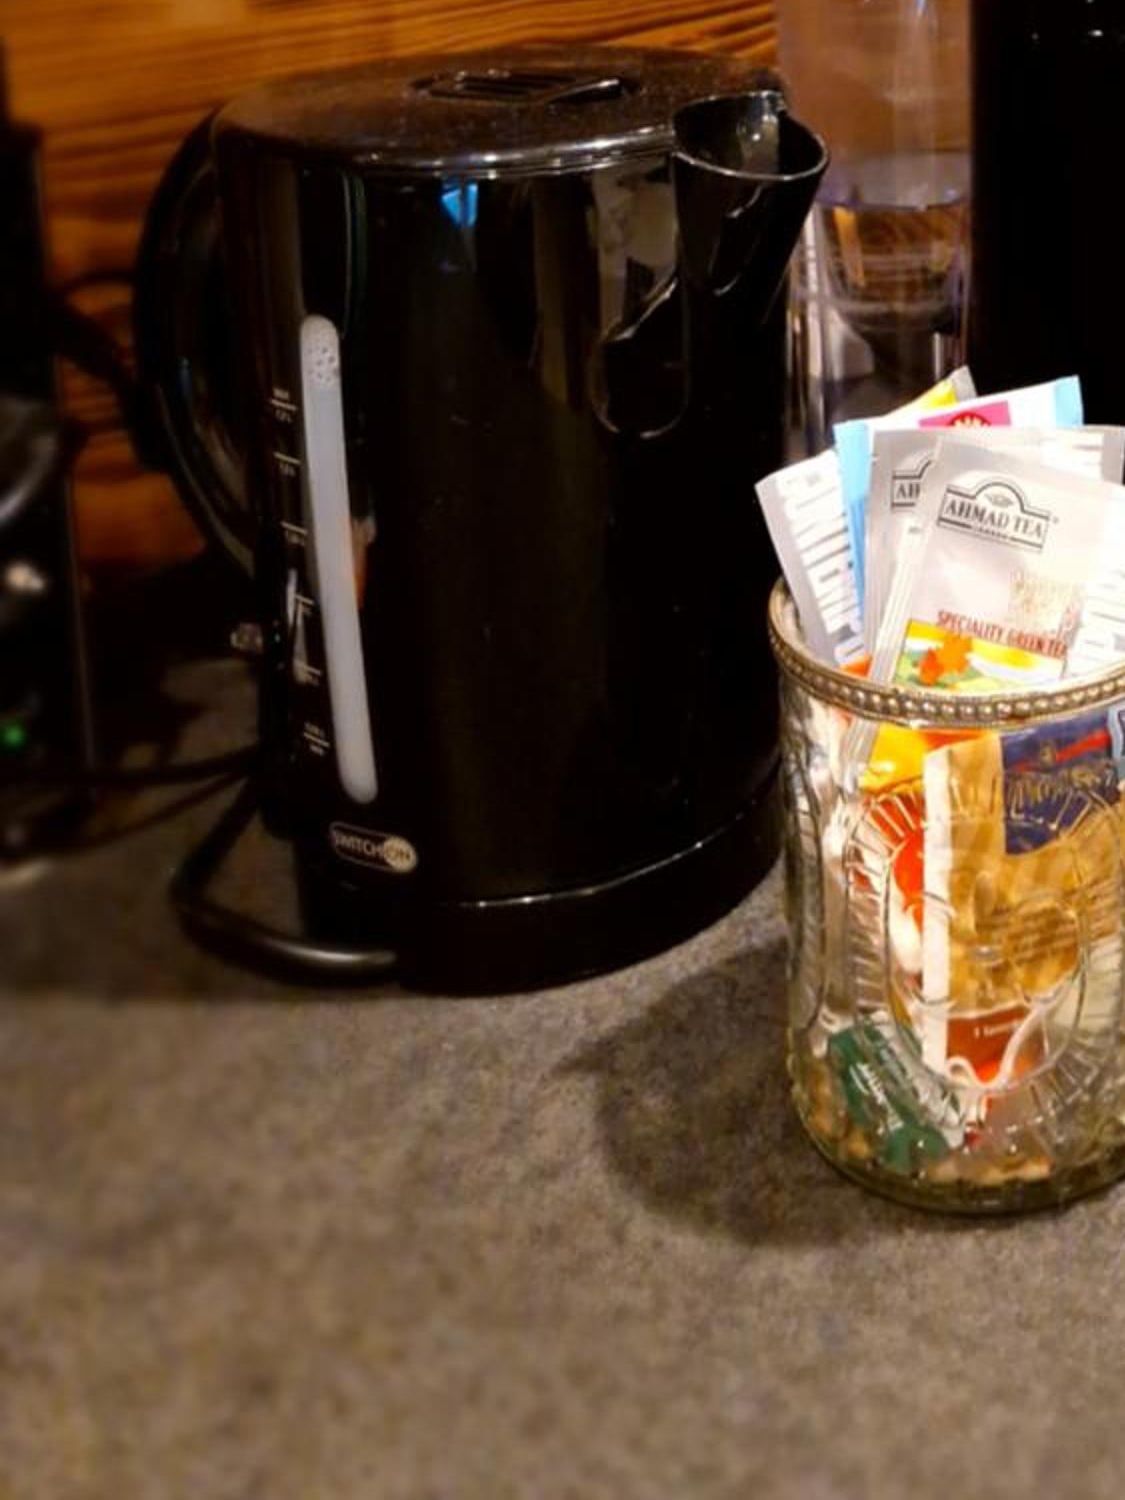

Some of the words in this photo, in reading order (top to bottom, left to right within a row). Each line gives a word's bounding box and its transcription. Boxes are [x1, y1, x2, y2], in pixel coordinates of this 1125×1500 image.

[945, 497, 1010, 529] AHMAD
[1014, 516, 1044, 540] TEA
[937, 609, 1005, 643] SPECIALITY
[1007, 628, 1046, 654] GREEN
